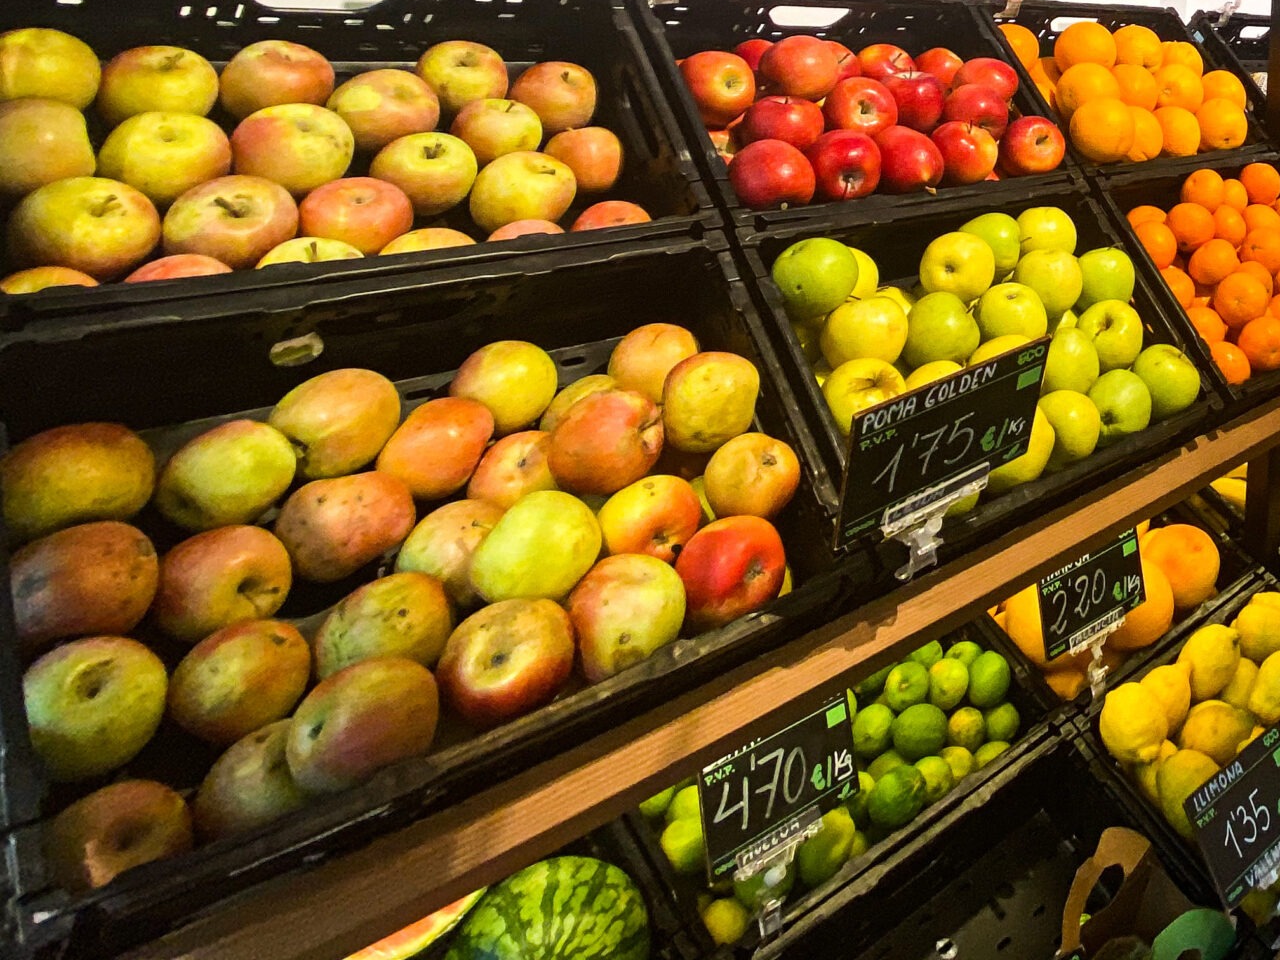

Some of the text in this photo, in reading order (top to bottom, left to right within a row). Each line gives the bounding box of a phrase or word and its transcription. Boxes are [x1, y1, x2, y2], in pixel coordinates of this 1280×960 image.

[862, 363, 997, 434] POMA GOLDEN
[859, 429, 898, 451] P.V.P.
[872, 411, 975, 493] 1'75
[1050, 568, 1106, 635] 2'20
[704, 764, 736, 786] P.V.P.
[713, 746, 806, 830] 4'70
[1193, 761, 1245, 812] LLIMONA
[1224, 788, 1271, 858] 1'35
